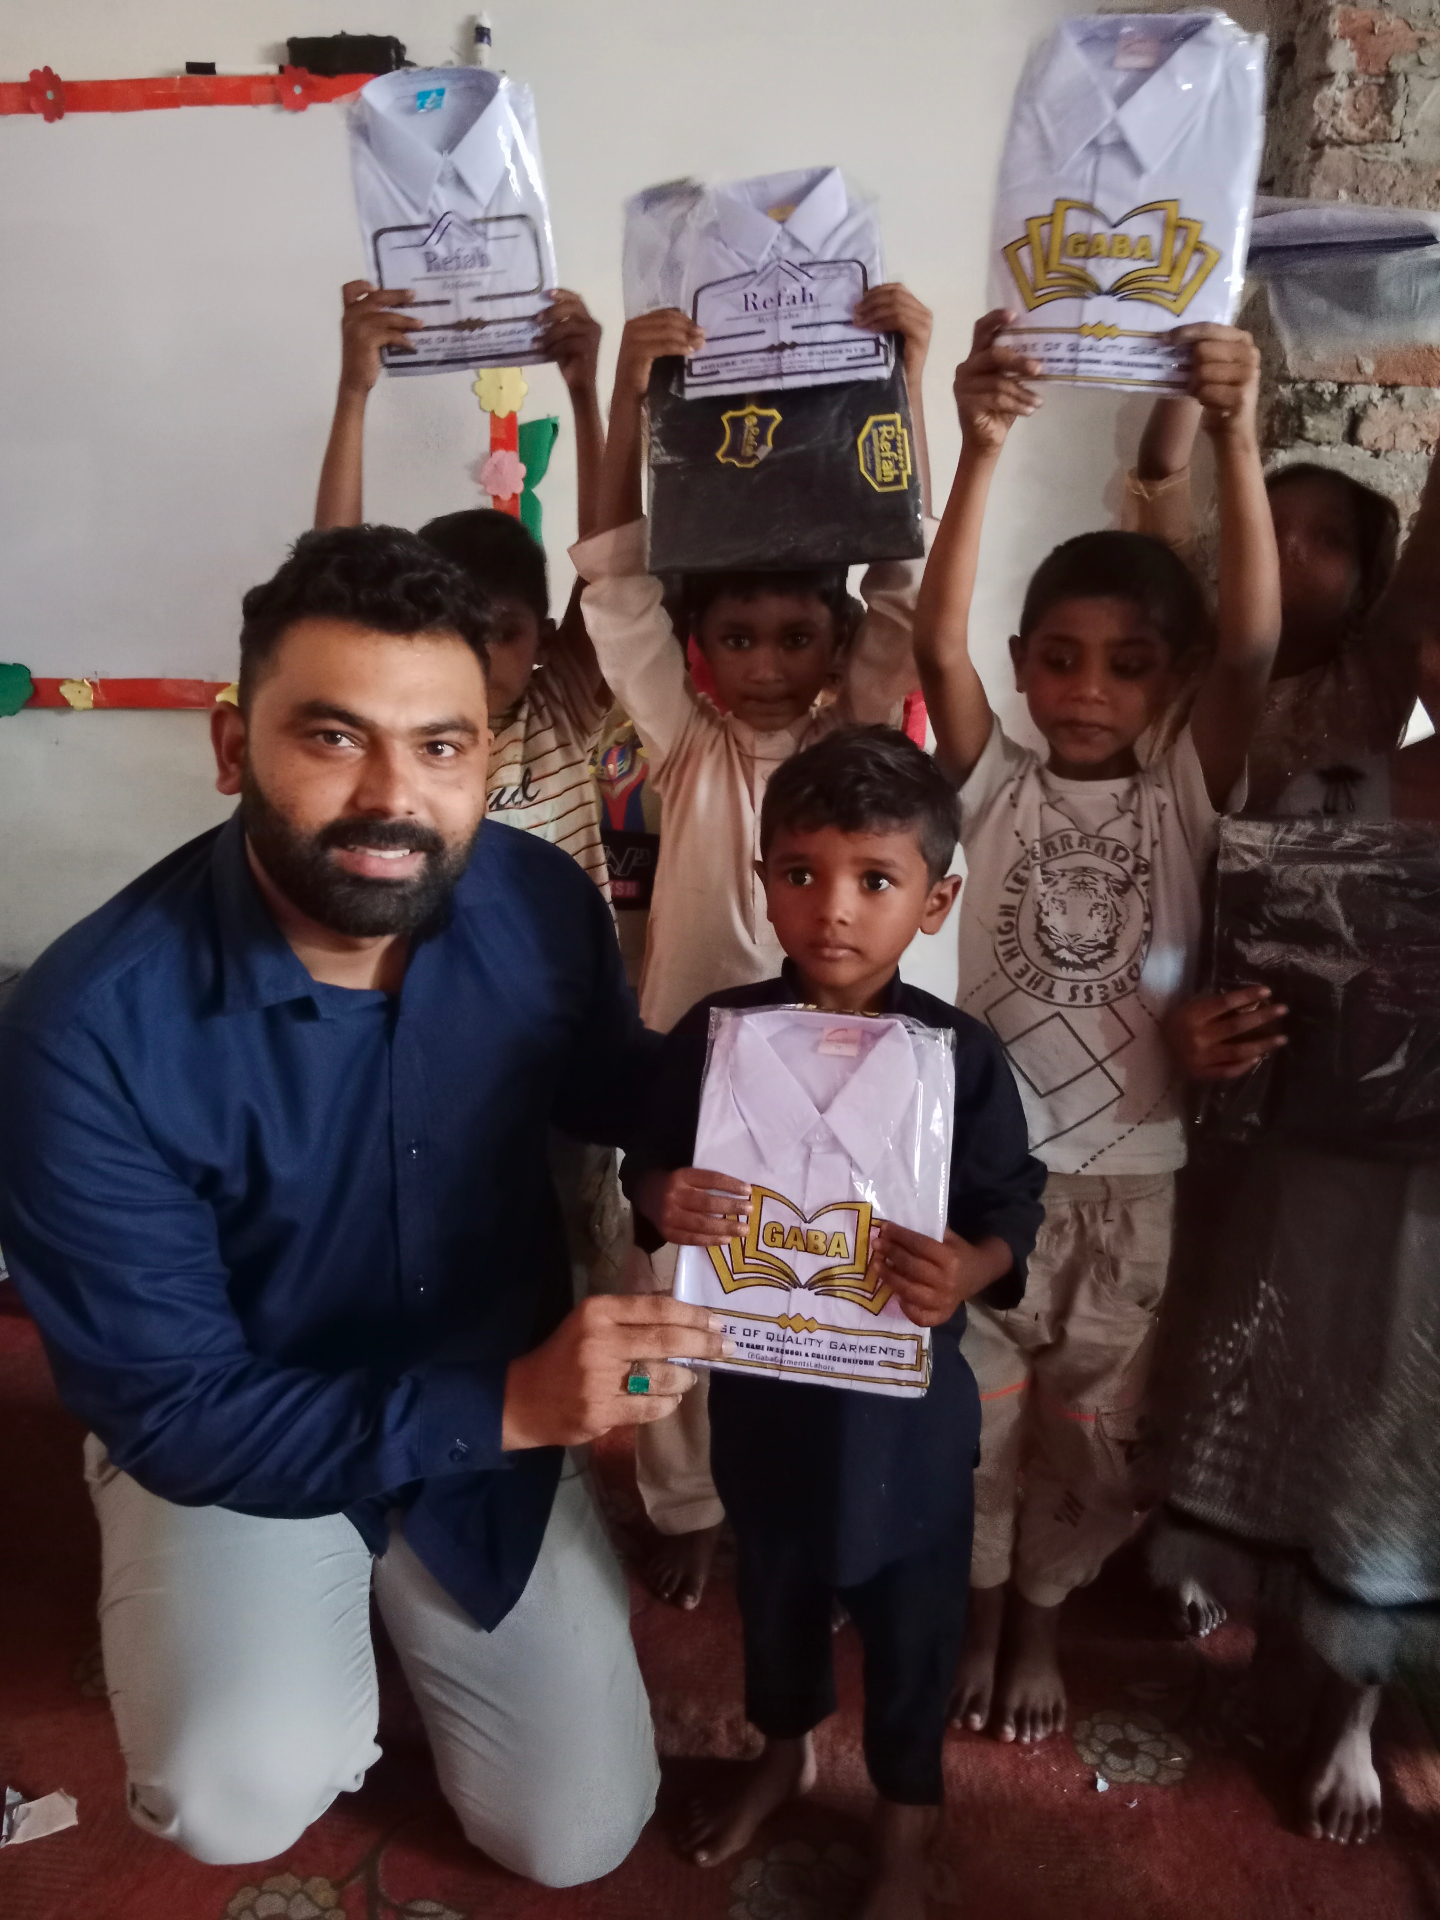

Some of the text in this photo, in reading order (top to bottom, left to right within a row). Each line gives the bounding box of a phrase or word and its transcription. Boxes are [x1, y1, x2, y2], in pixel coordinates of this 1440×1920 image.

[1066, 233, 1153, 260] GABA
[743, 285, 813, 311] Refah
[878, 424, 900, 483] Refah
[997, 904, 1021, 963] HIGH
[1013, 963, 1056, 999] THE
[763, 1221, 849, 1259] GABA
[742, 1328, 760, 1338] OF
[766, 1332, 824, 1347] QUALITY
[829, 1341, 905, 1358] GARMENTS
[745, 1343, 765, 1351] NAME
[775, 1347, 802, 1357] SCHOOL
[811, 1352, 840, 1363] COLLEGE
[842, 1357, 875, 1366] UNIFORM
